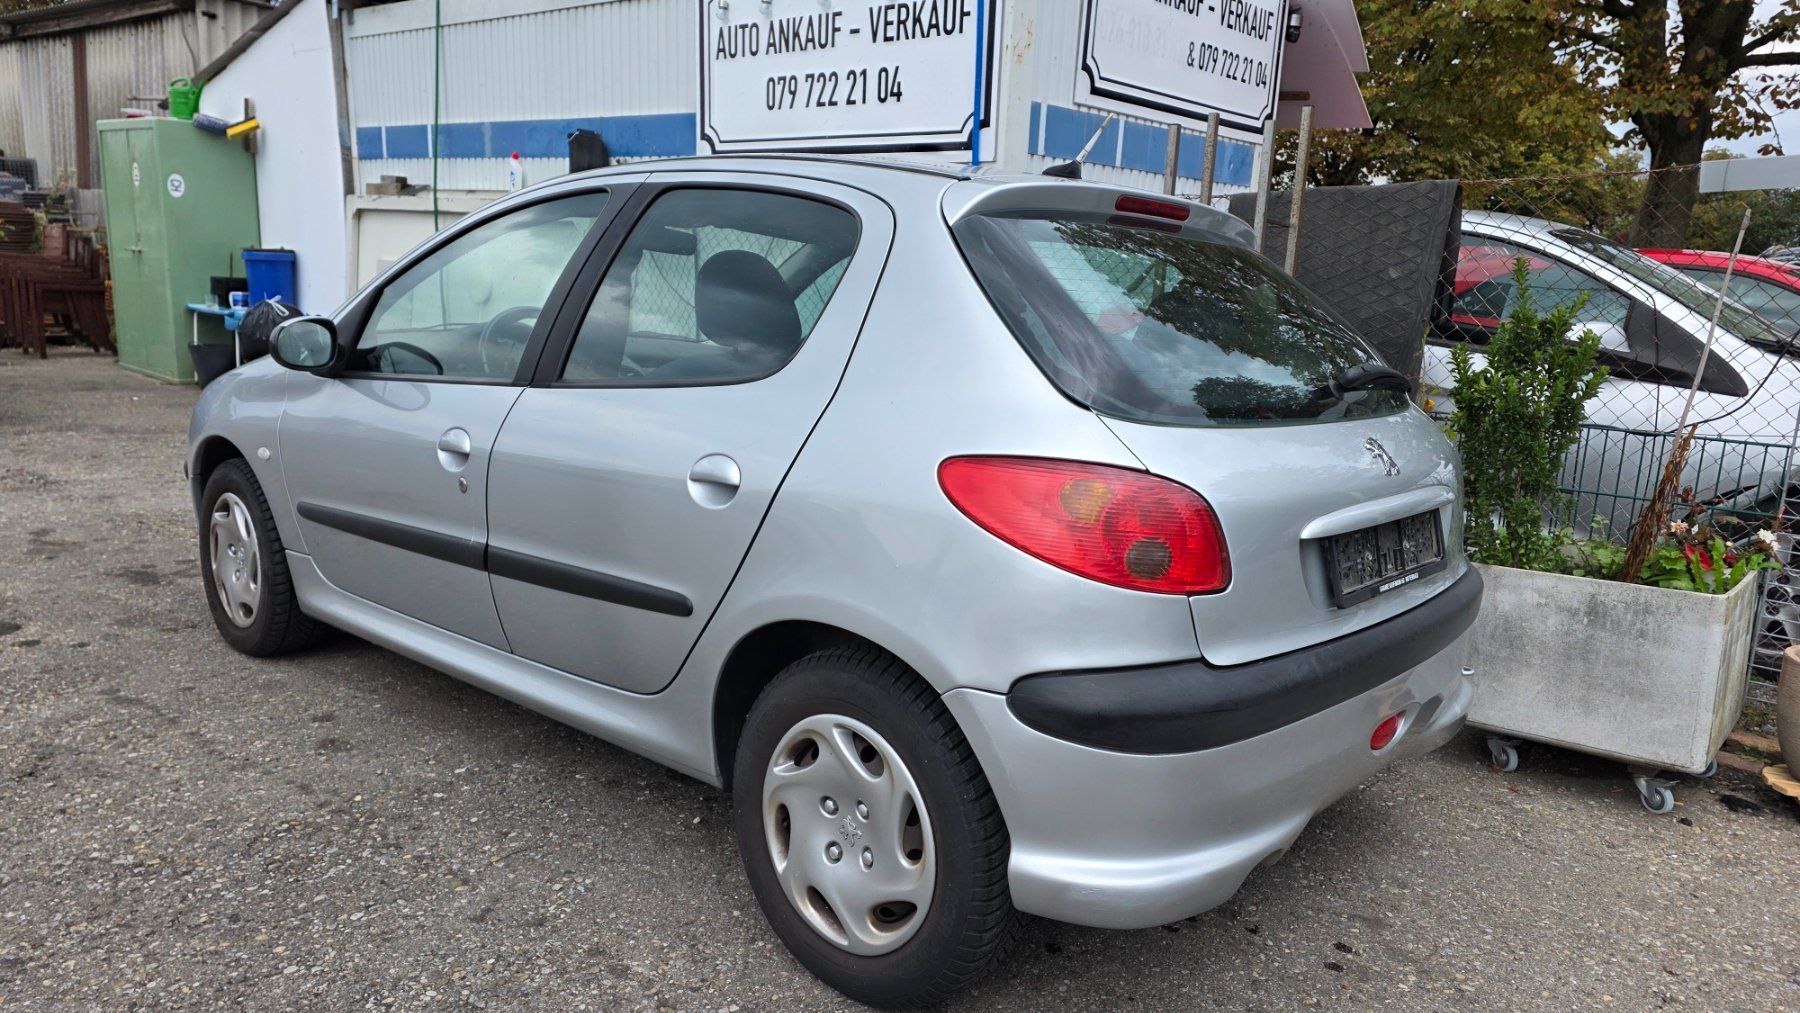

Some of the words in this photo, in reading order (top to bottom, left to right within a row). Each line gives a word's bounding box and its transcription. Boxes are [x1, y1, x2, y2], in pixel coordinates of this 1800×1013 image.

[716, 23, 760, 60] AUTO
[765, 11, 843, 55] ANKAUF
[869, 0, 971, 44] VERKAUF
[1220, 0, 1274, 42] VERKAUF
[1187, 41, 1195, 68] &
[1198, 42, 1219, 74] 079
[1220, 49, 1240, 81] 722
[1241, 56, 1254, 85] 21
[1255, 60, 1268, 89] 04
[766, 75, 798, 111] 079
[804, 71, 839, 109] 722
[845, 68, 868, 106] 21
[877, 66, 903, 104] 04
